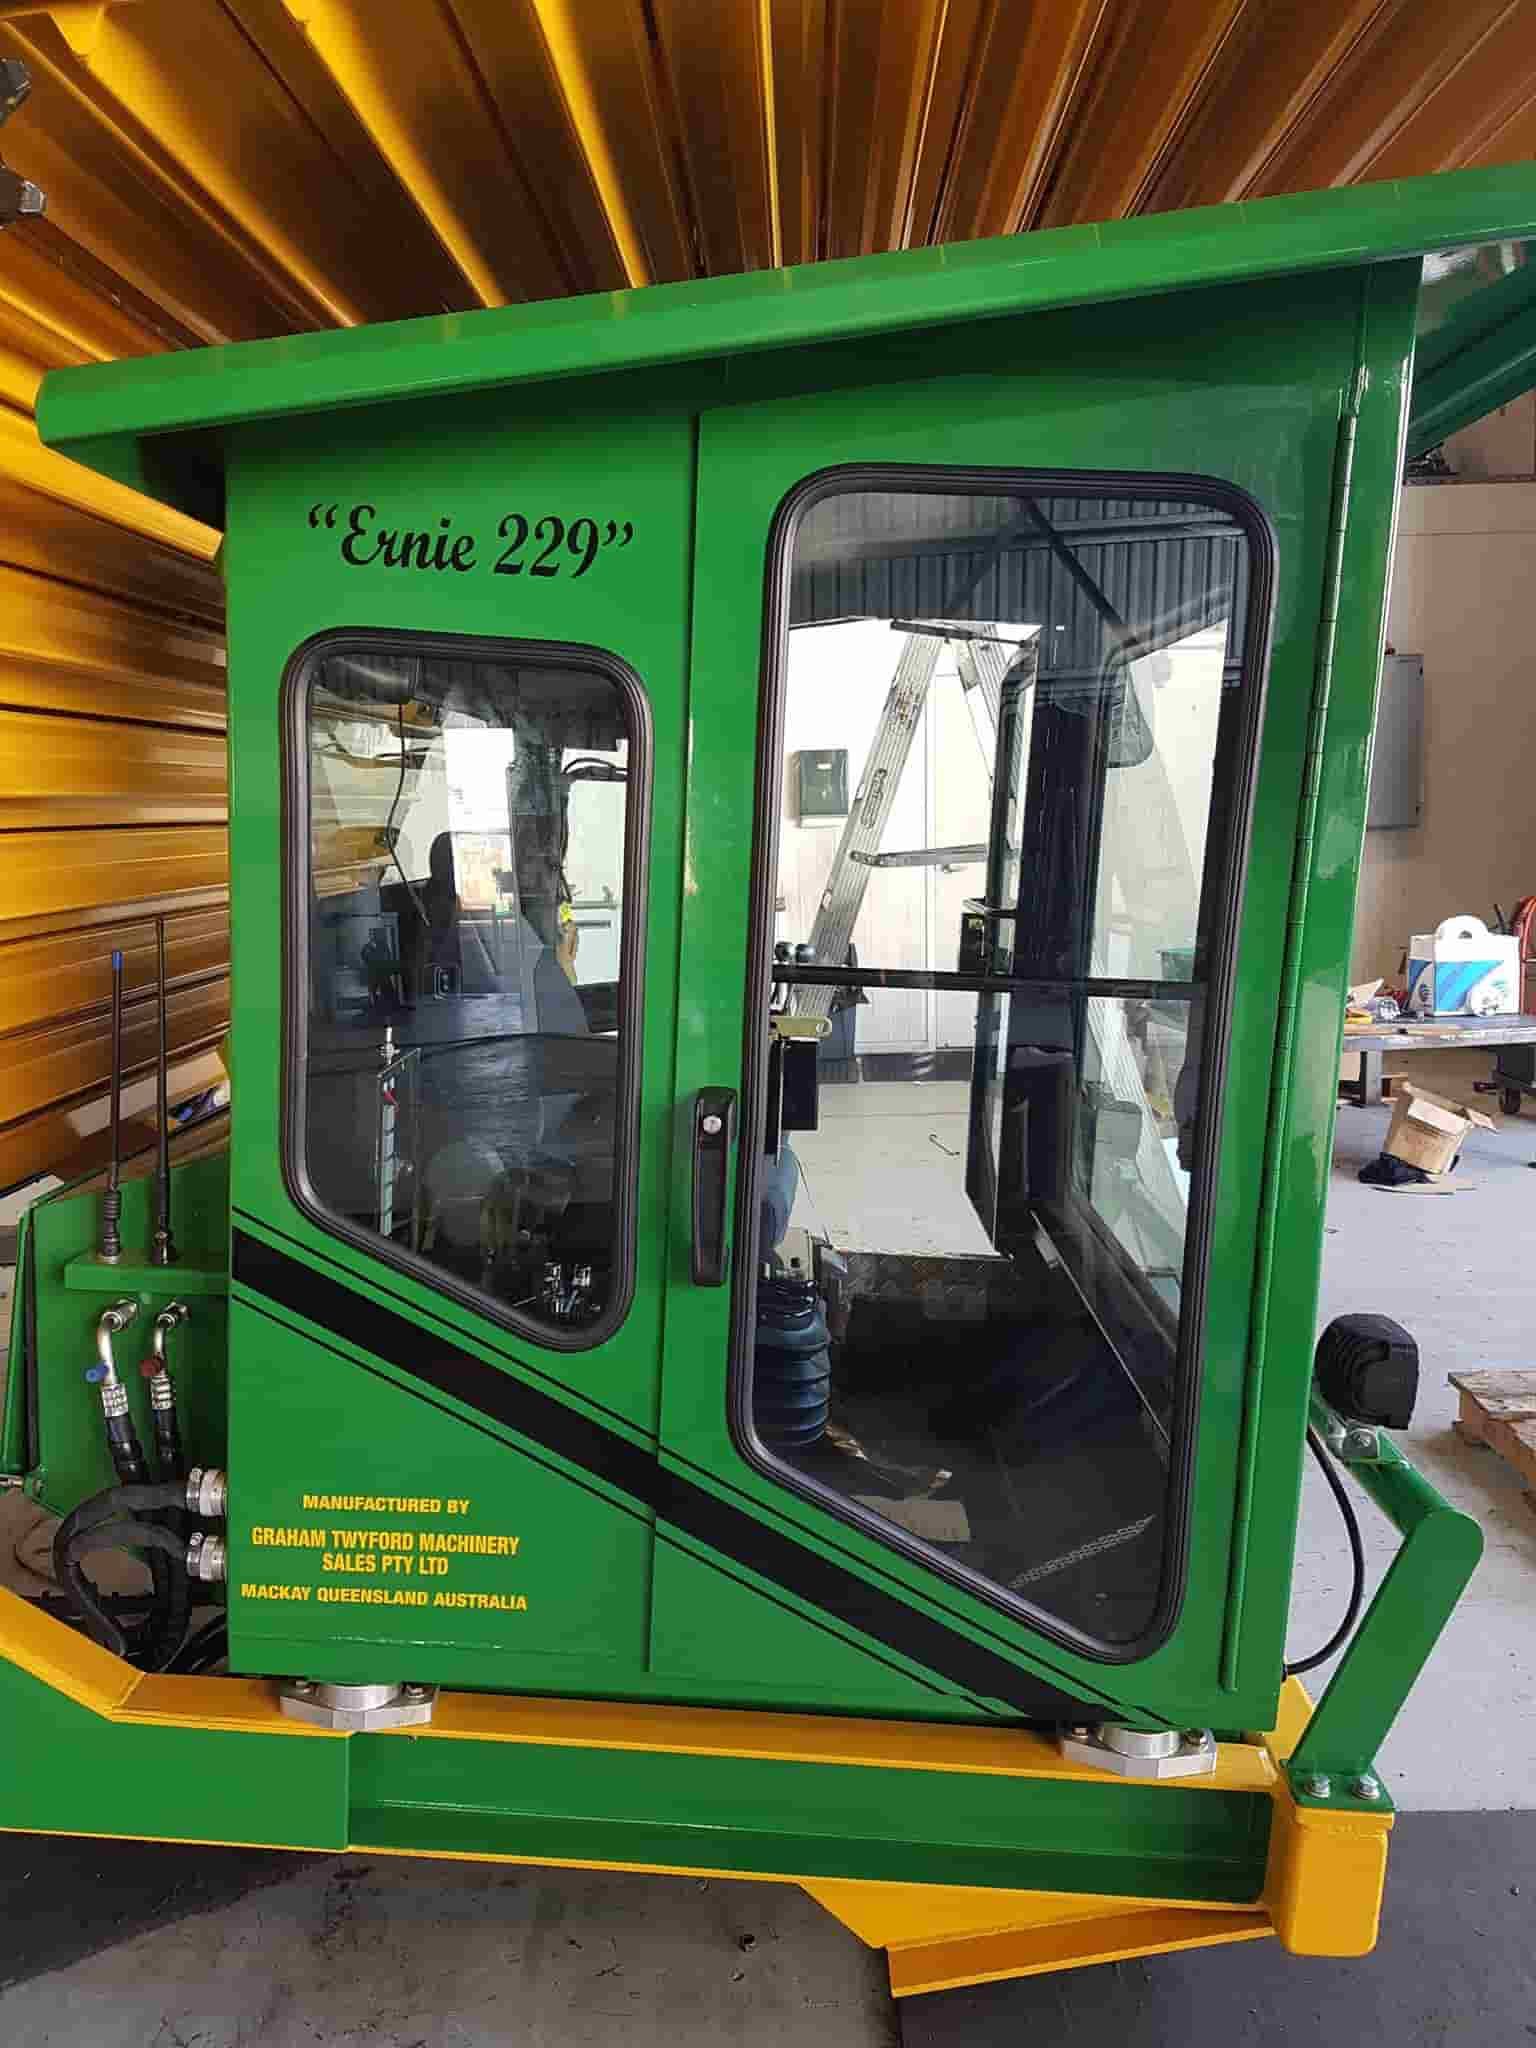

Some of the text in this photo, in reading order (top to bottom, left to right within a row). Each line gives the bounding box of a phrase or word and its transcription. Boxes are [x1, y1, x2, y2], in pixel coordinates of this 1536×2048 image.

[308, 503, 634, 578] “Ernie 229”
[302, 1495, 470, 1514] MANUFACTURED BY
[251, 1527, 520, 1556] GRAHAM TWYFORD MACHINERY
[322, 1551, 449, 1576] SALES PTY LTD
[241, 1583, 528, 1611] MACKAY QUEENSLAND AUSTRALIA
